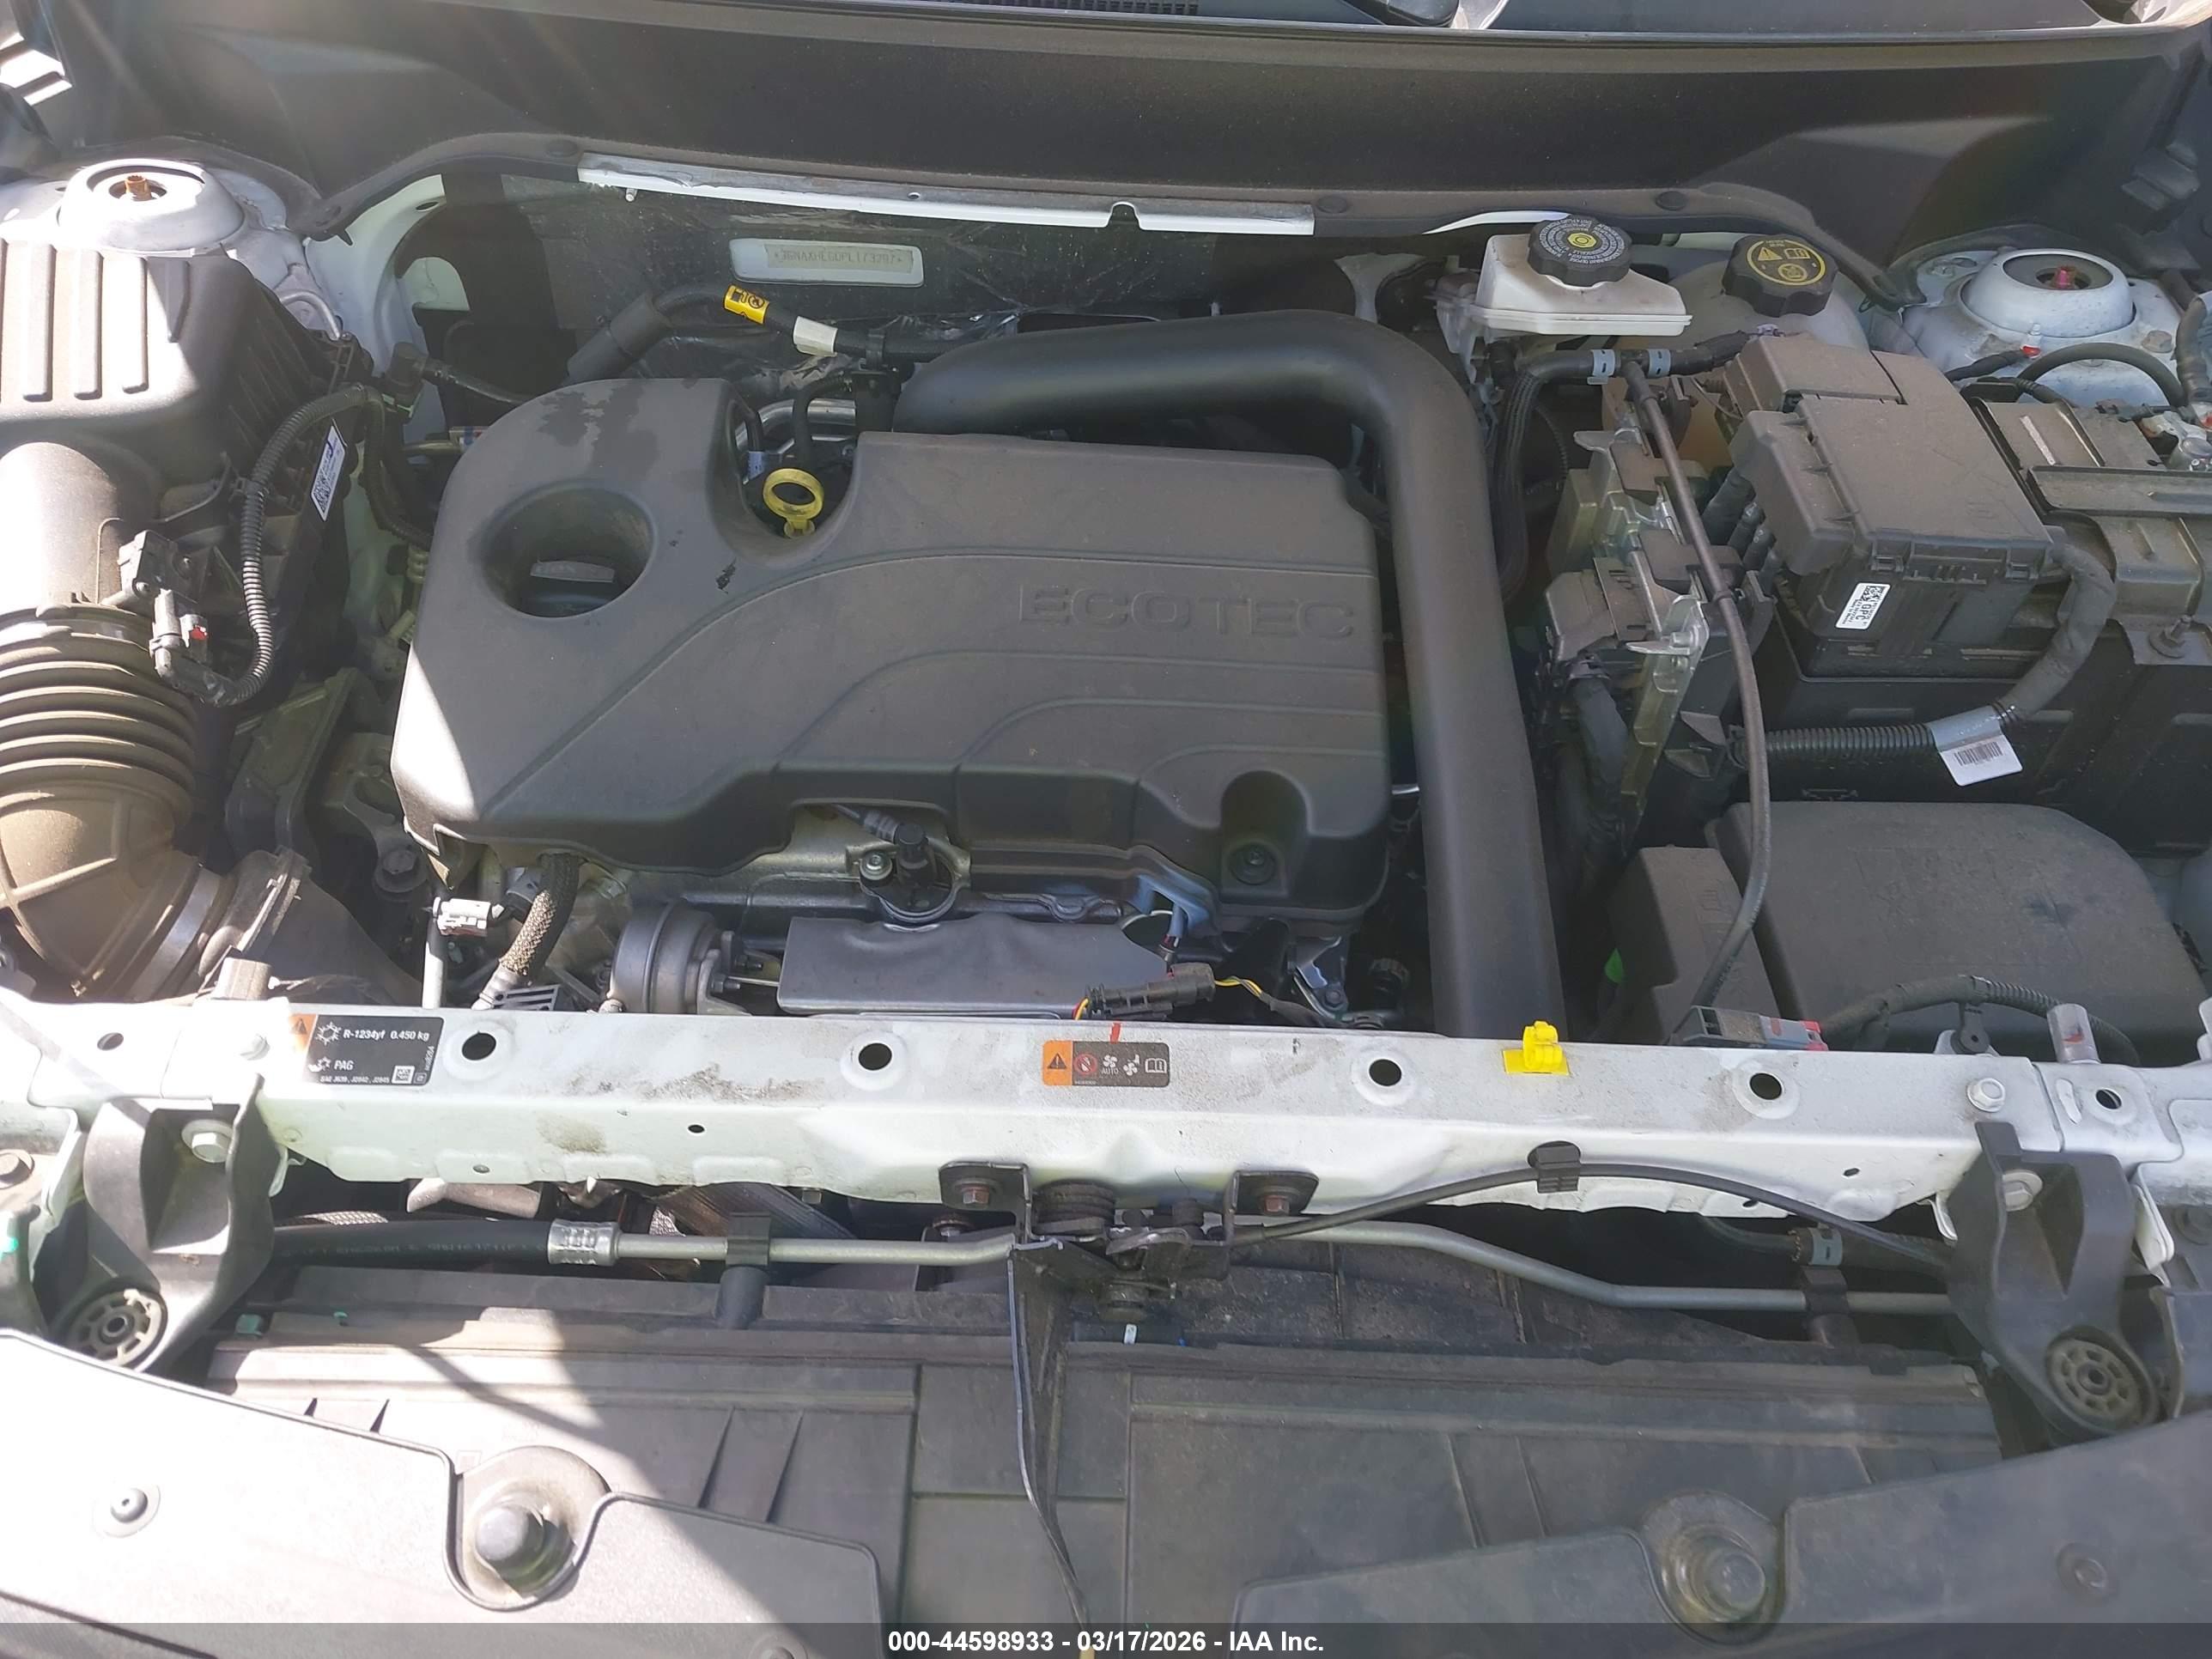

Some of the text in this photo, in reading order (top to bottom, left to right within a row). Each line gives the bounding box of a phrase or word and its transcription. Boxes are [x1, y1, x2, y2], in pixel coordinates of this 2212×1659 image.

[1018, 583, 1355, 639] ECOTEC
[343, 1029, 430, 1042] R-1234yf 0.450 kg
[334, 1060, 355, 1072] PAG
[1102, 1067, 1120, 1076] AUTO
